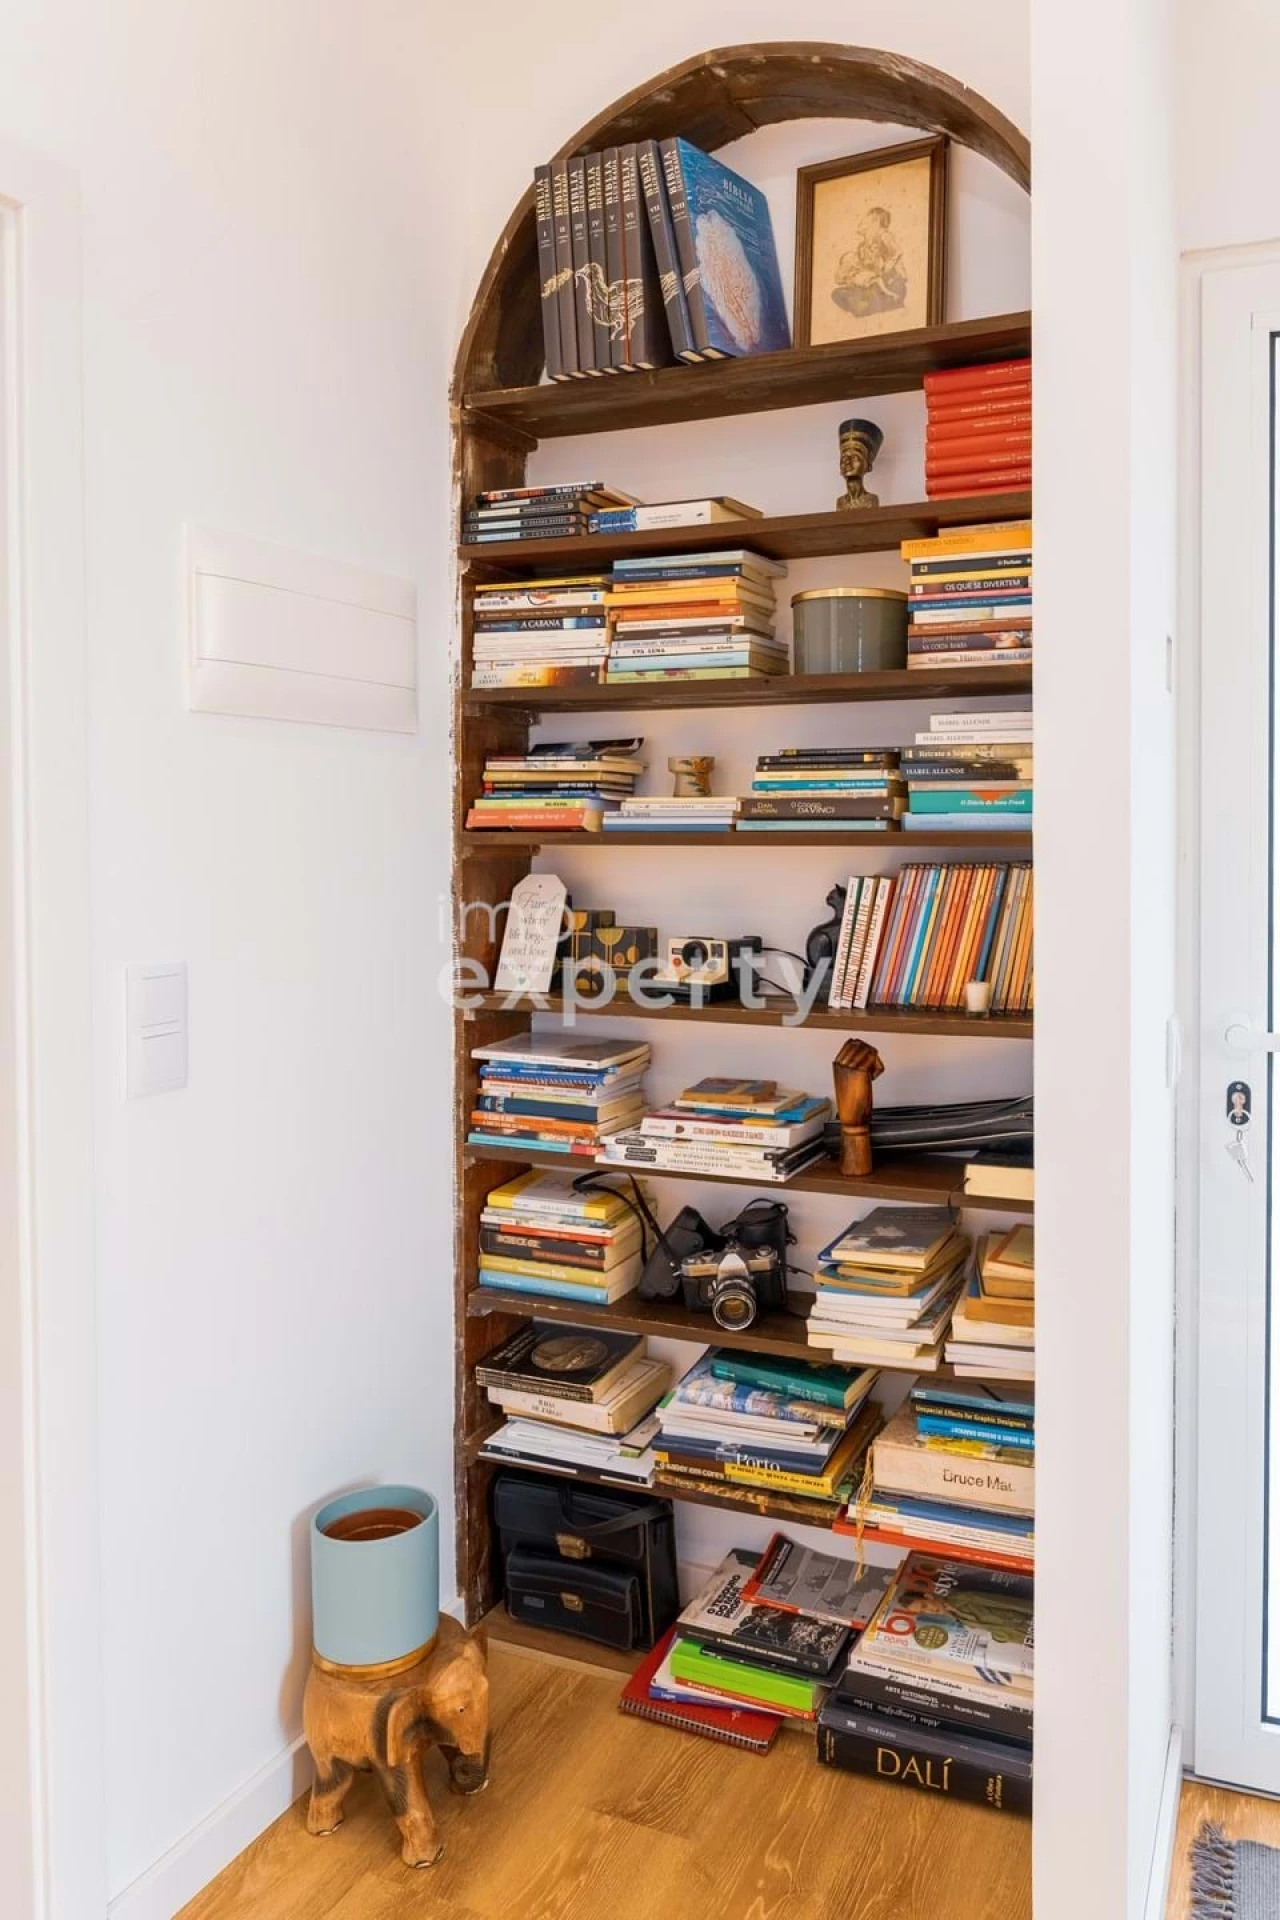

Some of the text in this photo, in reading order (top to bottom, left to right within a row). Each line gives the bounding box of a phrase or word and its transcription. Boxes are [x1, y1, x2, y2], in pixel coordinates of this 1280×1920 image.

[983, 579, 1021, 589] DIVERTEM
[528, 619, 560, 629] CABANA
[932, 767, 965, 775] ALLENDE
[736, 1452, 780, 1471] Porto
[943, 1468, 984, 1487] Bruce
[934, 1563, 959, 1597] style
[876, 1747, 953, 1791] DALÍ
